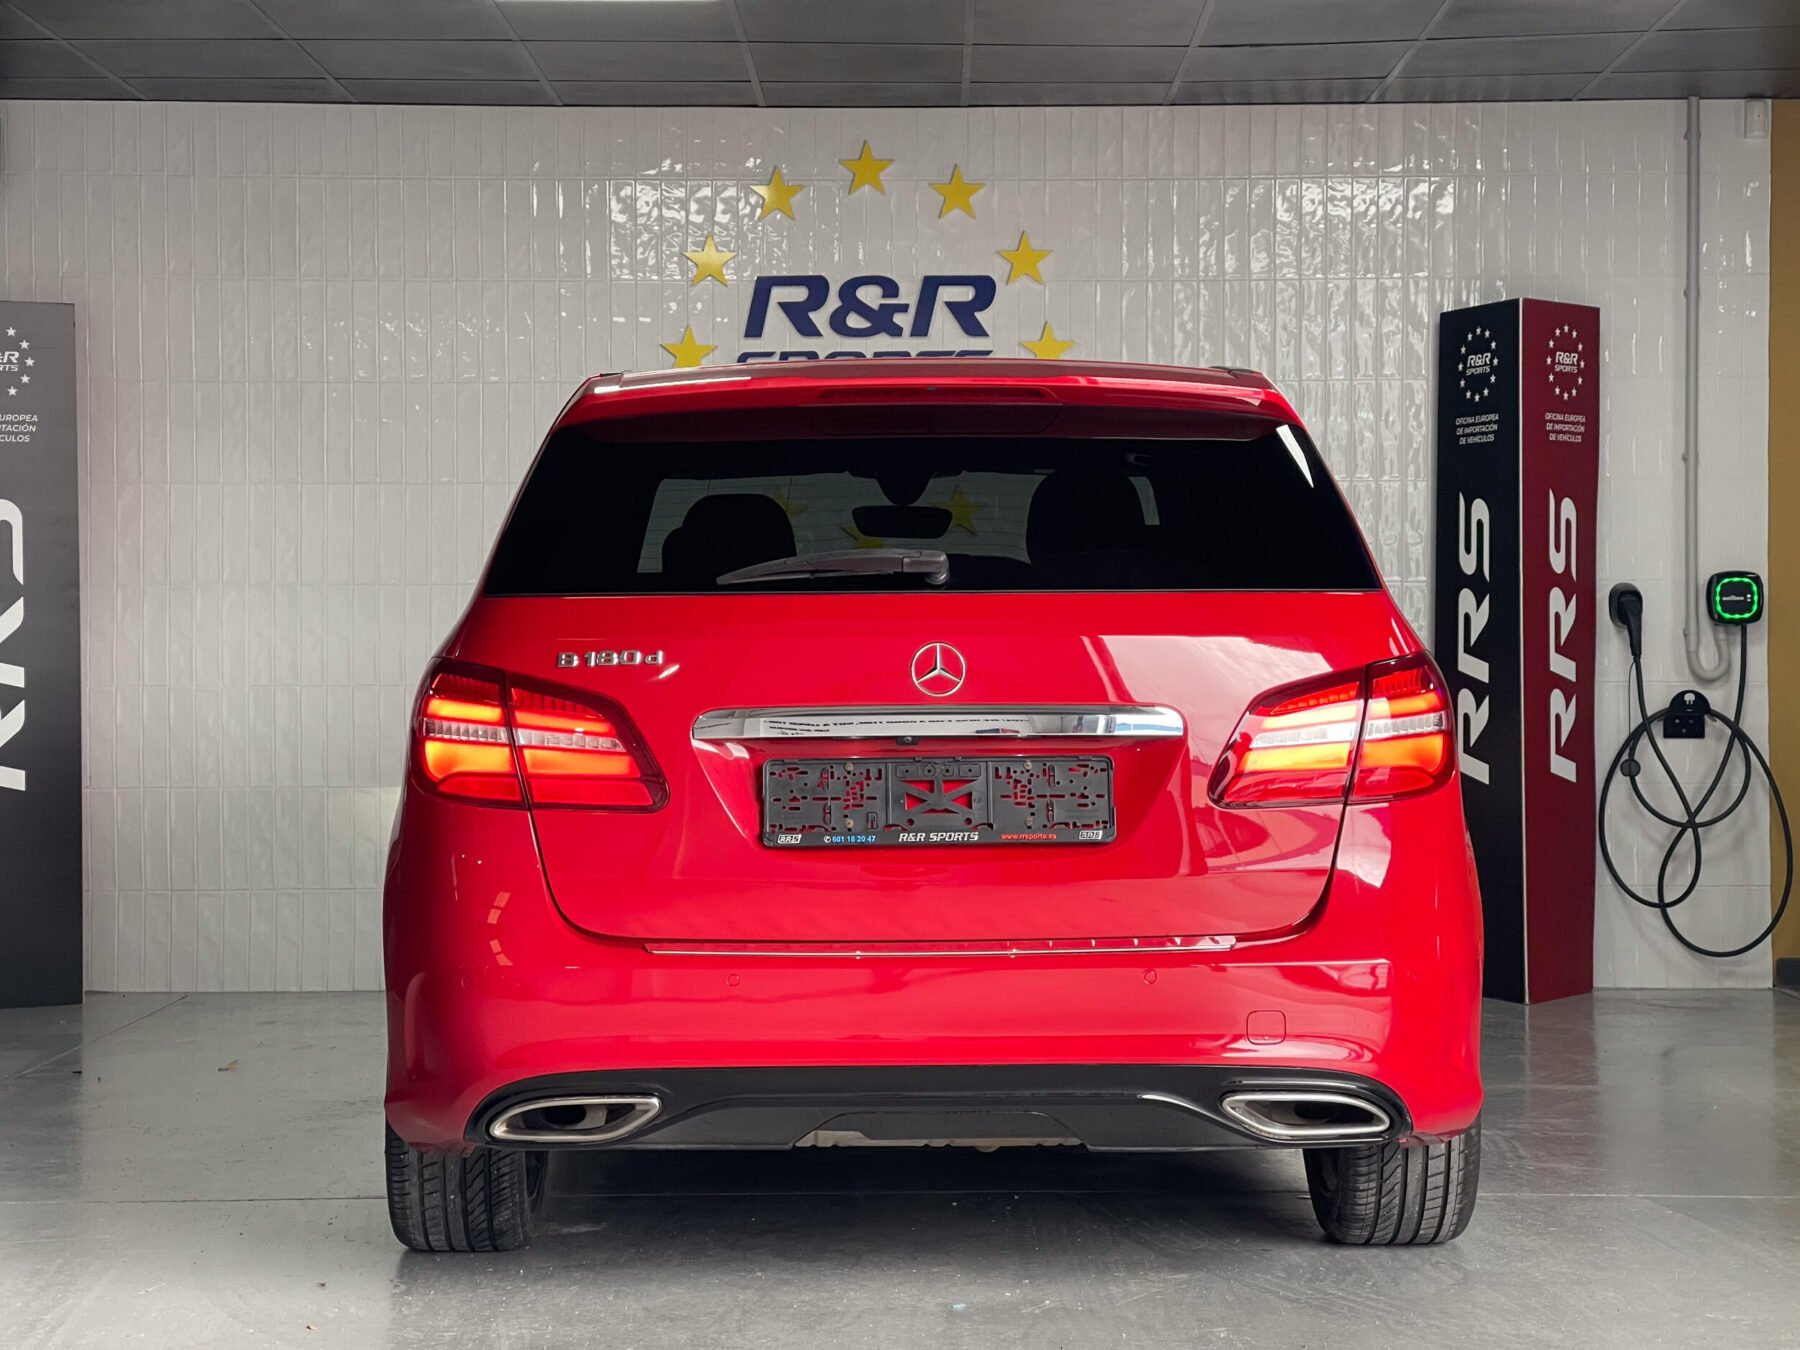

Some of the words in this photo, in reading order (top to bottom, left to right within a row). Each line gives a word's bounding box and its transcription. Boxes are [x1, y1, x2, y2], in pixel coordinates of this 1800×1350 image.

[744, 275, 996, 337] R&R
[1467, 353, 1491, 367] R&R
[1556, 351, 1578, 365] R&R
[1466, 366, 1490, 376] SPORTS
[1555, 364, 1578, 373] SPORTS
[1457, 490, 1490, 785] RRS
[1549, 487, 1577, 783] RRS
[898, 832, 926, 842] R&R
[929, 831, 979, 842] SPORTS
